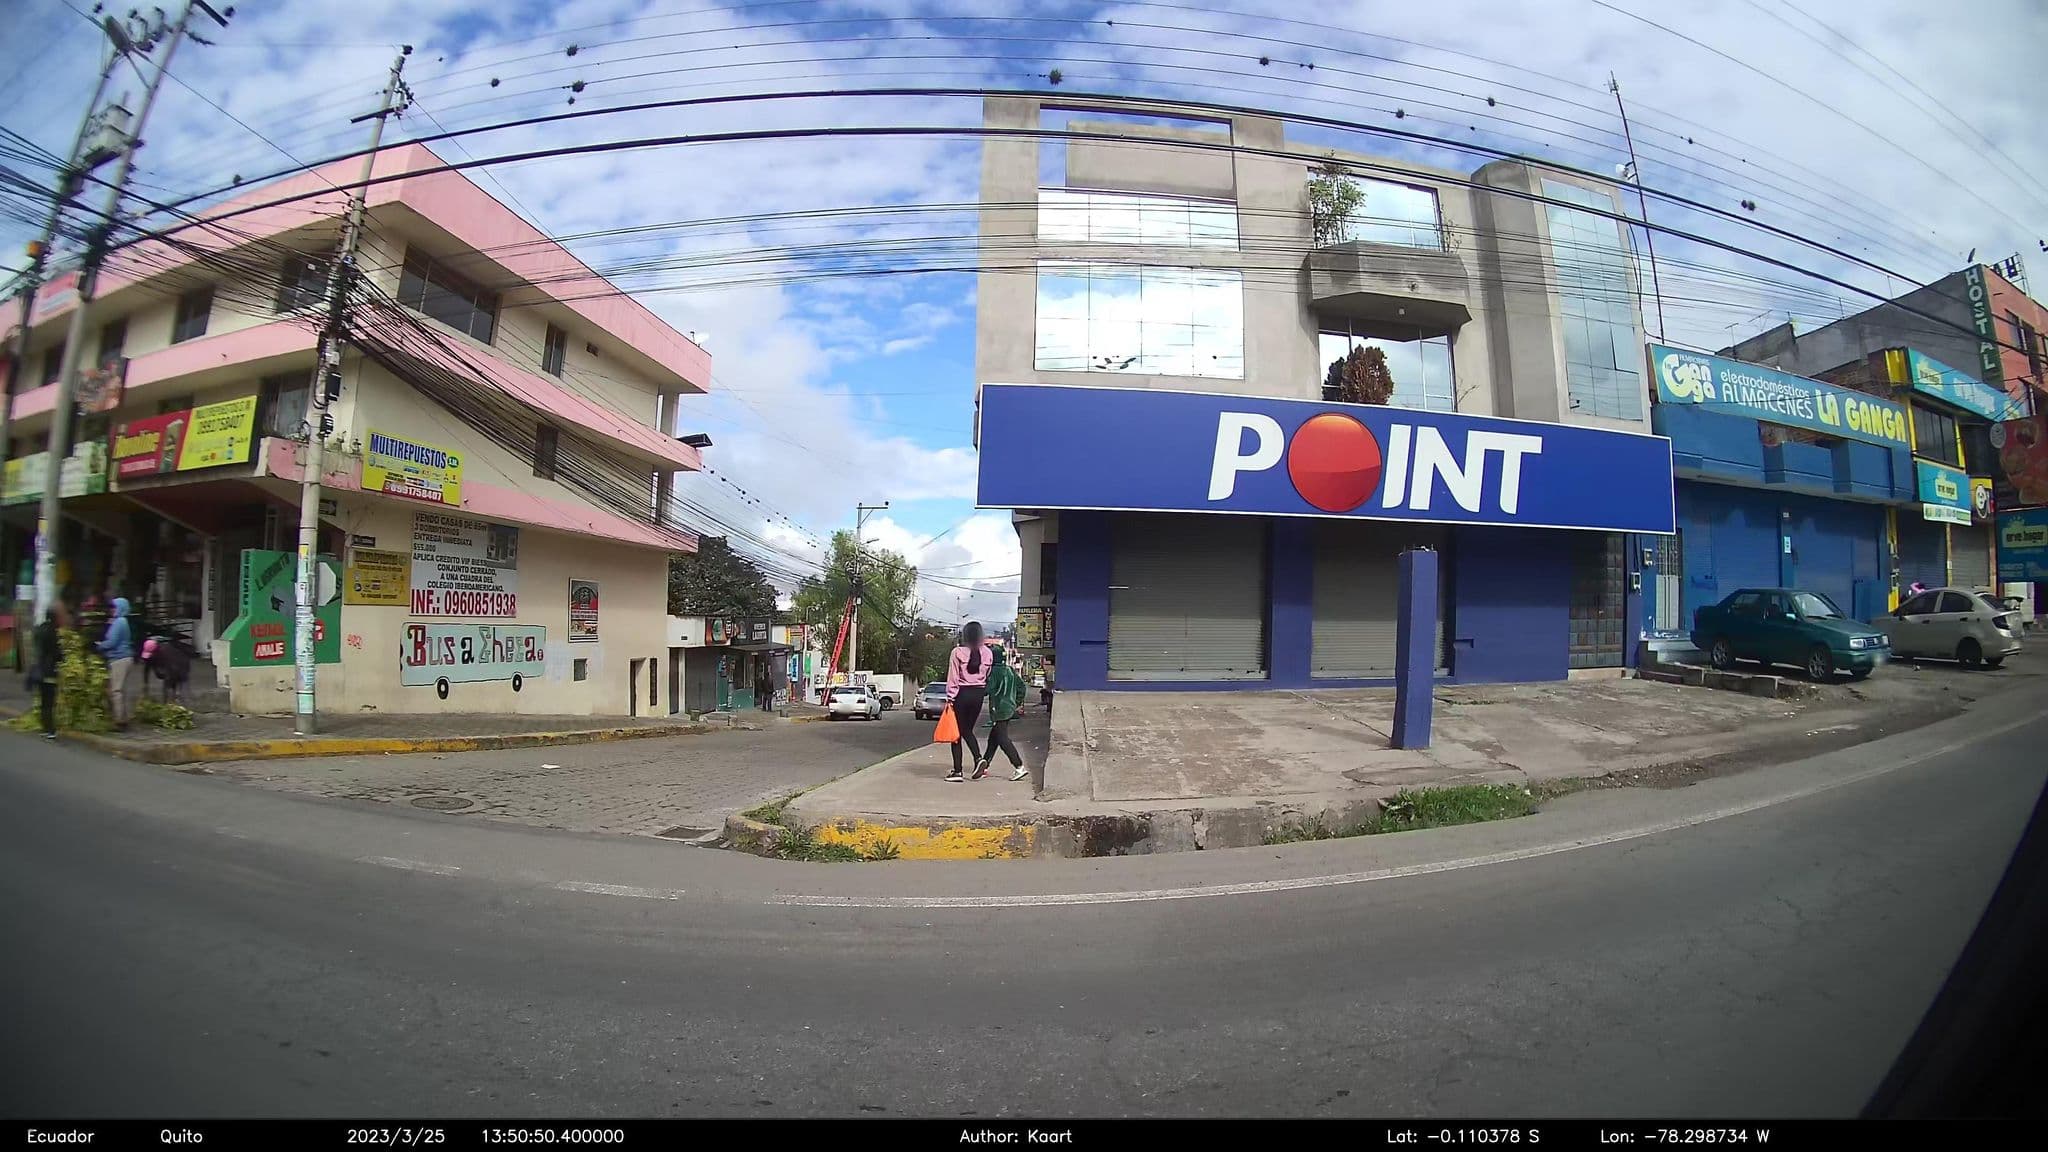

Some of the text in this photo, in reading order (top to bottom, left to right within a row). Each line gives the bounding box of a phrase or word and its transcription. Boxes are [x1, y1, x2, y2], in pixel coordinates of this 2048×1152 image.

[1964, 268, 1996, 370] HOSTAL
[1720, 370, 1811, 400] electrodomésticos
[1722, 382, 1907, 443] ALMACENES LA GANGA
[369, 432, 447, 469] MULTIREPUESTOS
[1208, 411, 1543, 514] POINT
[415, 513, 439, 525] VENDO
[441, 516, 463, 528] CASAS
[414, 532, 442, 543] ENTREGA
[413, 553, 435, 562] APLICA
[437, 563, 469, 574] CONJUNTO
[427, 580, 454, 590] COLEGIO
[446, 573, 459, 581] UNA
[460, 574, 482, 583] CUADRA
[483, 576, 494, 584] DEL
[411, 589, 516, 616] INF.: 0960851938
[407, 625, 456, 666] Bus
